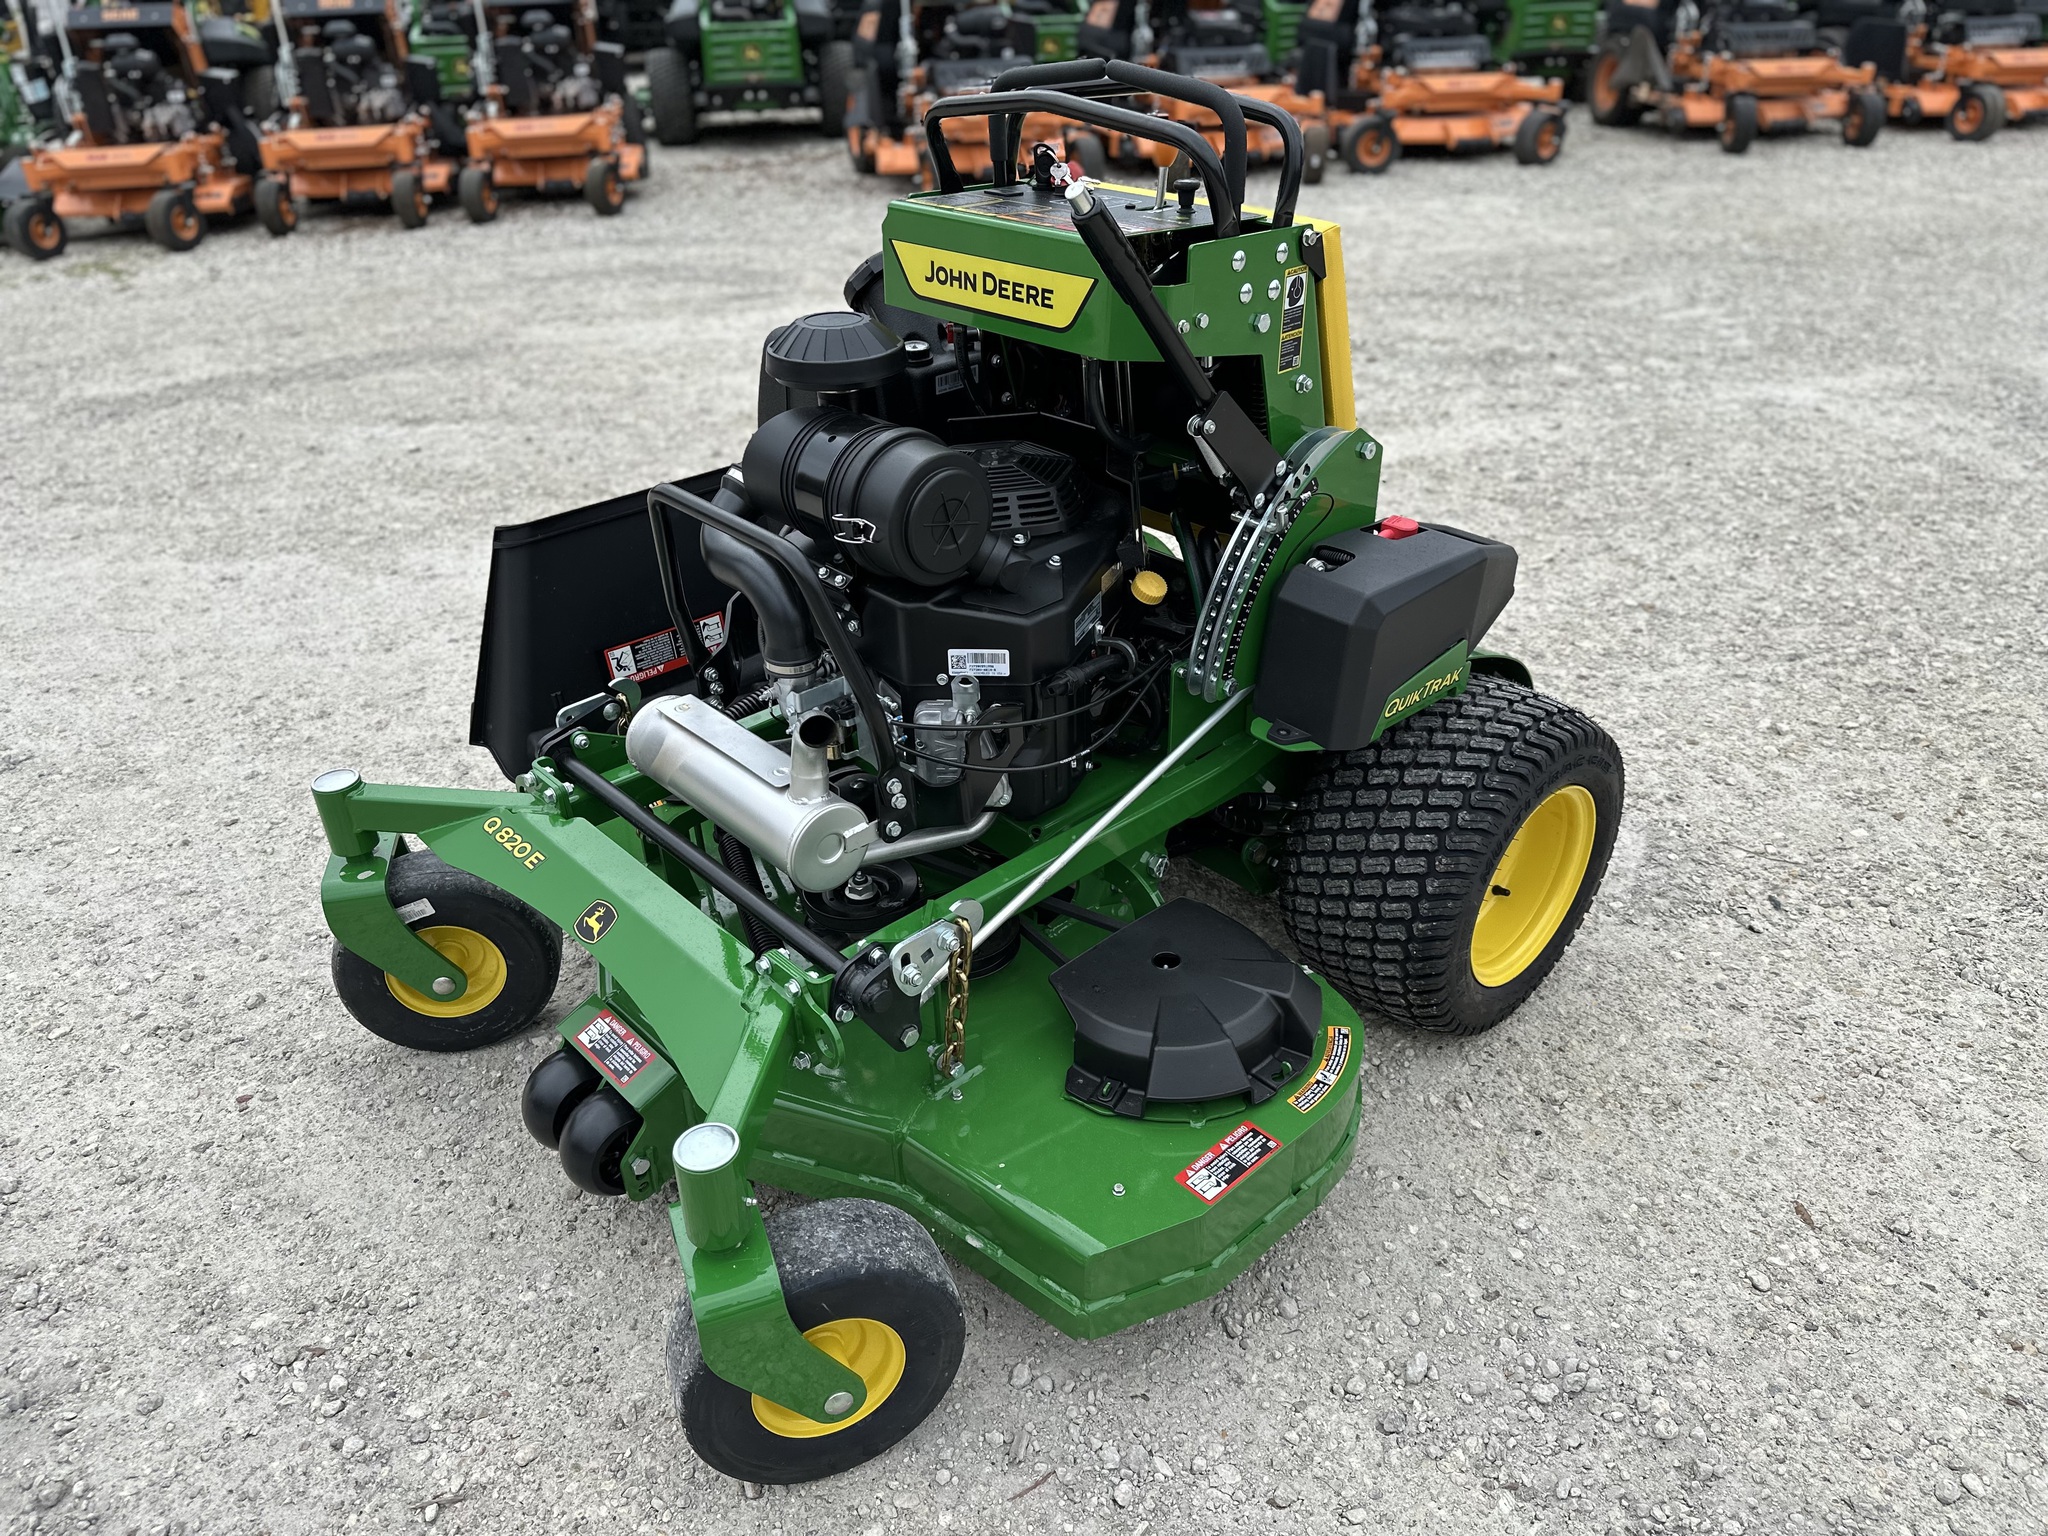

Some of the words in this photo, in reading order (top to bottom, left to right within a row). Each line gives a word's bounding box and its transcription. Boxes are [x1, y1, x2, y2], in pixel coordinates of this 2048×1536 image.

[924, 260, 977, 293] JOHN
[982, 271, 1054, 310] DEERE
[609, 1019, 627, 1037] DANGER
[632, 1041, 651, 1059] PELIGRO
[1191, 1151, 1216, 1171] DANGER
[1225, 1125, 1249, 1145] PELIGRO
